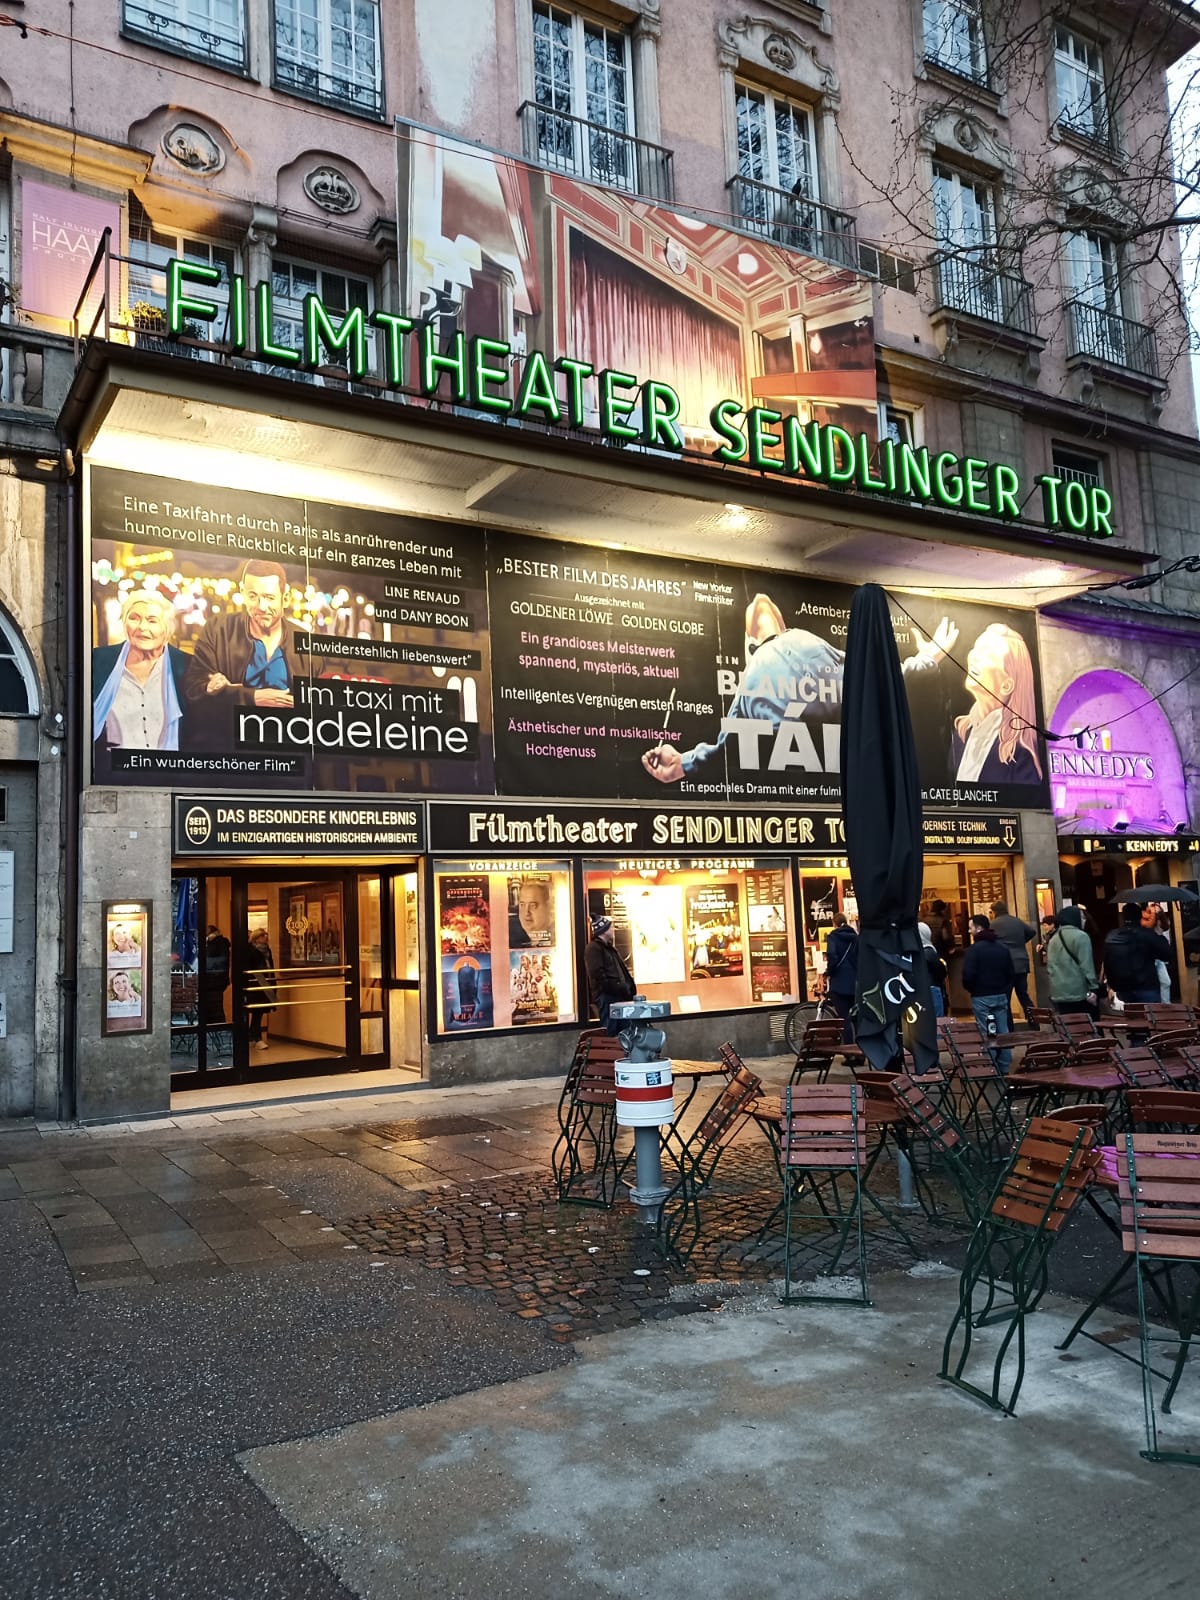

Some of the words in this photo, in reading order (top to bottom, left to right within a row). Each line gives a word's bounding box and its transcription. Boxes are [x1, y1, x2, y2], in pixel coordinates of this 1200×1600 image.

[167, 257, 684, 450] FILMTHEATER
[710, 399, 1021, 520] SENDLINGER
[1035, 474, 1114, 538] TOR
[123, 496, 159, 515] Eine
[163, 501, 233, 527] Taxifahrt
[236, 511, 279, 535] durch
[284, 520, 318, 541] Paris
[322, 524, 341, 543] als
[344, 531, 427, 556] anrührender
[429, 544, 454, 560] und
[124, 517, 222, 546] humorvoller
[227, 531, 296, 557] Rückblick
[299, 541, 325, 560] auf
[326, 549, 347, 564] ein
[351, 553, 396, 573] ganzes
[400, 557, 438, 577] Leben
[441, 563, 462, 579] mit
[563, 567, 598, 585] FILM
[602, 573, 629, 590] DES
[385, 586, 410, 599] LINE
[413, 589, 460, 605] RENAUD
[574, 593, 631, 609] Ausgezeichnet
[631, 601, 645, 610] mit
[375, 607, 397, 619] und
[401, 608, 432, 624] DANY
[435, 612, 469, 627] BOON
[510, 601, 576, 622] GOLDENER
[579, 609, 613, 625] LÖWE
[621, 615, 667, 631] GOLDEN
[669, 620, 705, 636] GLOBE
[795, 602, 851, 620] „Atembera
[830, 624, 848, 636] OSC
[521, 632, 539, 645] Ein
[543, 635, 605, 651] grandioses
[607, 641, 676, 659] Meisterwerk
[518, 654, 580, 672] spannend,
[584, 660, 640, 678] mysteriös,
[643, 666, 680, 679] aktuell
[716, 655, 739, 665] EIN
[300, 681, 334, 706] im
[343, 686, 393, 712] taxi
[402, 691, 443, 714] mit
[500, 686, 575, 704] Intelligentes
[576, 692, 638, 711] Vergnügen
[640, 700, 674, 711] ersten
[677, 701, 714, 715] Ranges
[239, 712, 469, 753] madeleine
[508, 717, 580, 736] Ästhetischer
[584, 722, 606, 736] und
[610, 725, 682, 742] musikalischer
[526, 743, 597, 760] Hochgenuss
[155, 756, 261, 772] wunderschöner
[1050, 752, 1155, 779] ENNEDY'S
[680, 782, 696, 792] Ein
[698, 783, 744, 795] epochales
[747, 783, 777, 795] Drama
[779, 784, 794, 795] mit
[795, 785, 818, 796] einer
[929, 788, 951, 800] CATE
[953, 789, 999, 802] BLANCHET
[188, 817, 206, 826] SEIT
[217, 809, 245, 824] DAS
[248, 809, 326, 825] BESONDERE
[329, 810, 417, 826] KINOERLEBNIS
[958, 821, 988, 832] TECHNIK
[189, 827, 207, 836] 1913
[469, 811, 639, 845] Filmtheater
[652, 814, 815, 845] SENDLINGER
[217, 832, 229, 843] IM
[232, 832, 304, 844] EINZIGARTIGEN
[306, 832, 376, 844] HISTORISCHEN
[374, 832, 418, 844] AMBIENTE
[1126, 840, 1179, 852] KENNEDY'S
[469, 862, 538, 871] VORANZEIGE
[619, 860, 681, 870] HEUTIGES
[691, 859, 755, 869] PROGRAMM
